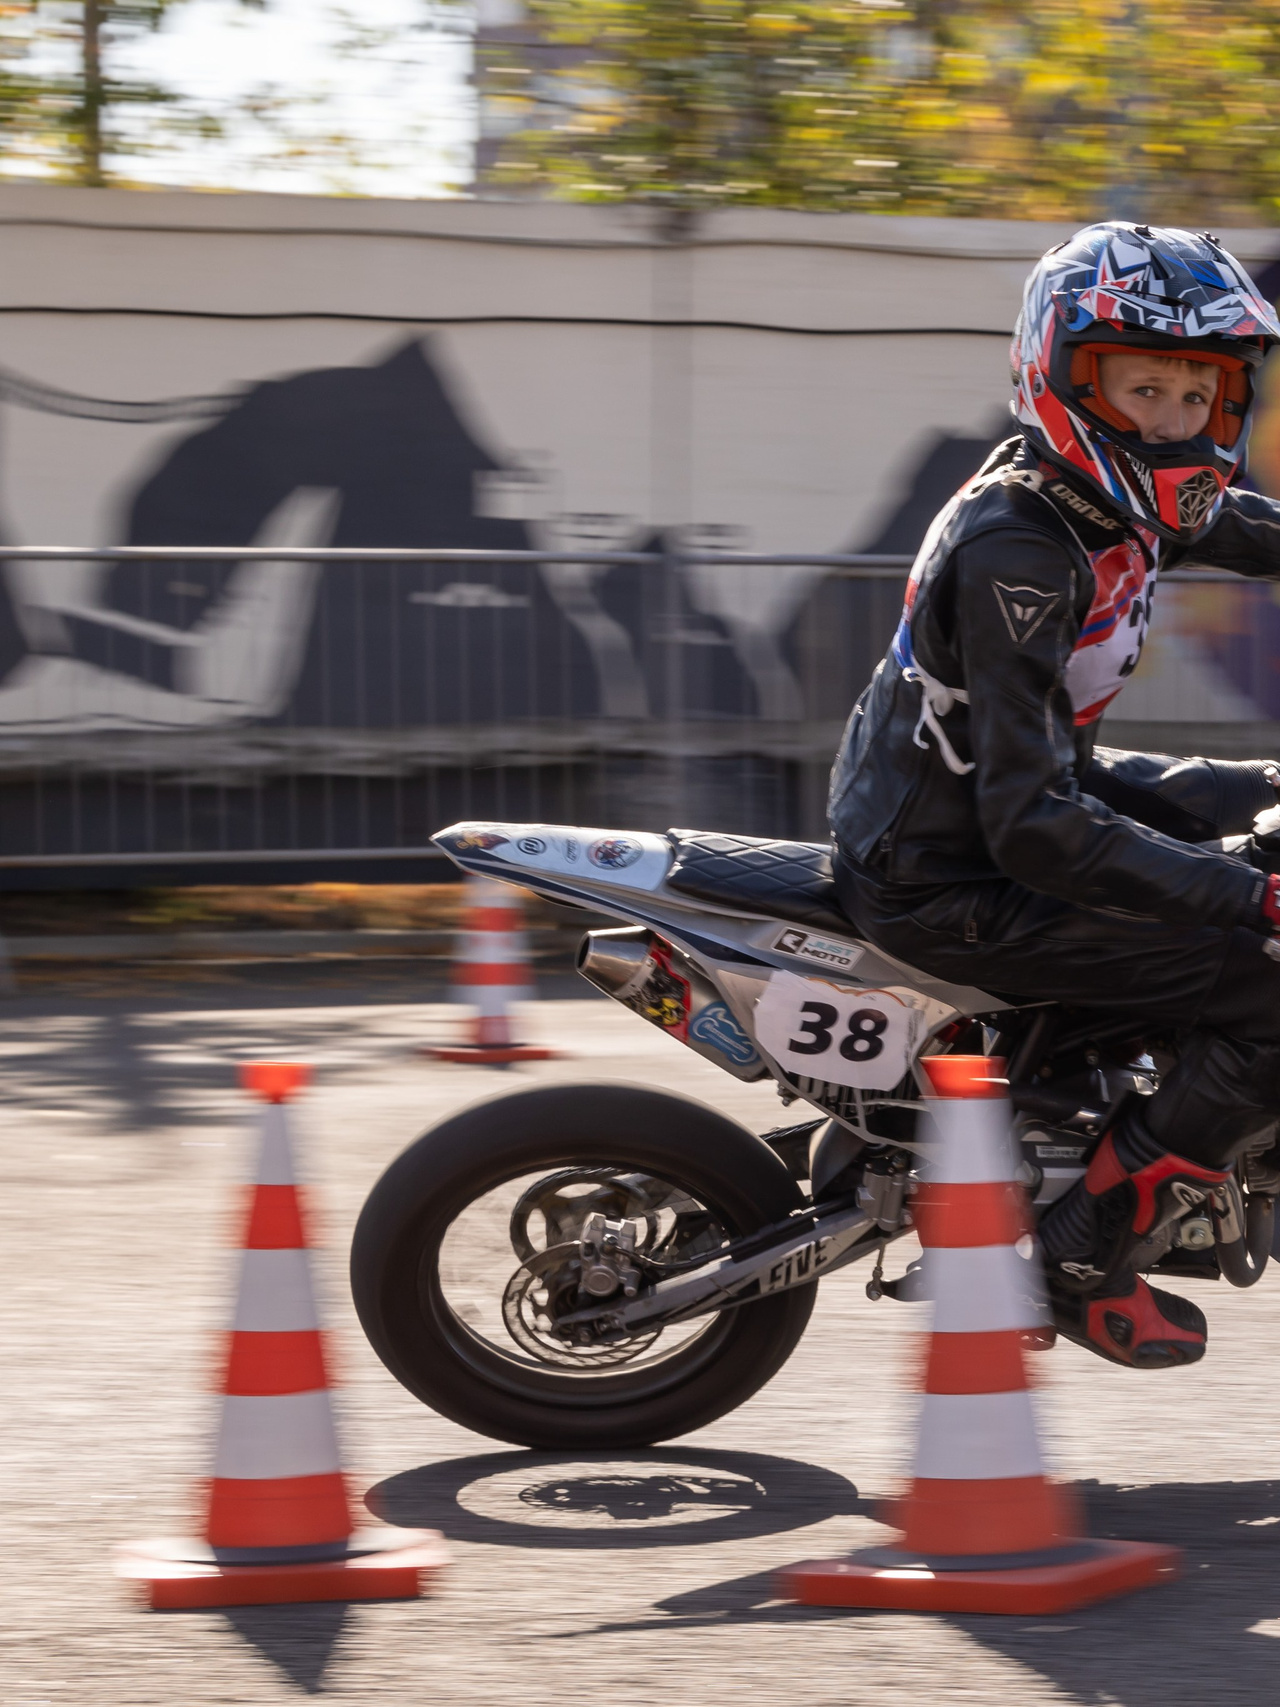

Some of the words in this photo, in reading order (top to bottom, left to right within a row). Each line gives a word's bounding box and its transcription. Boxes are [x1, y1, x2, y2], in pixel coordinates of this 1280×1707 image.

[800, 946, 852, 966] MOTO
[807, 940, 855, 956] JUST
[788, 1000, 889, 1062] 38
